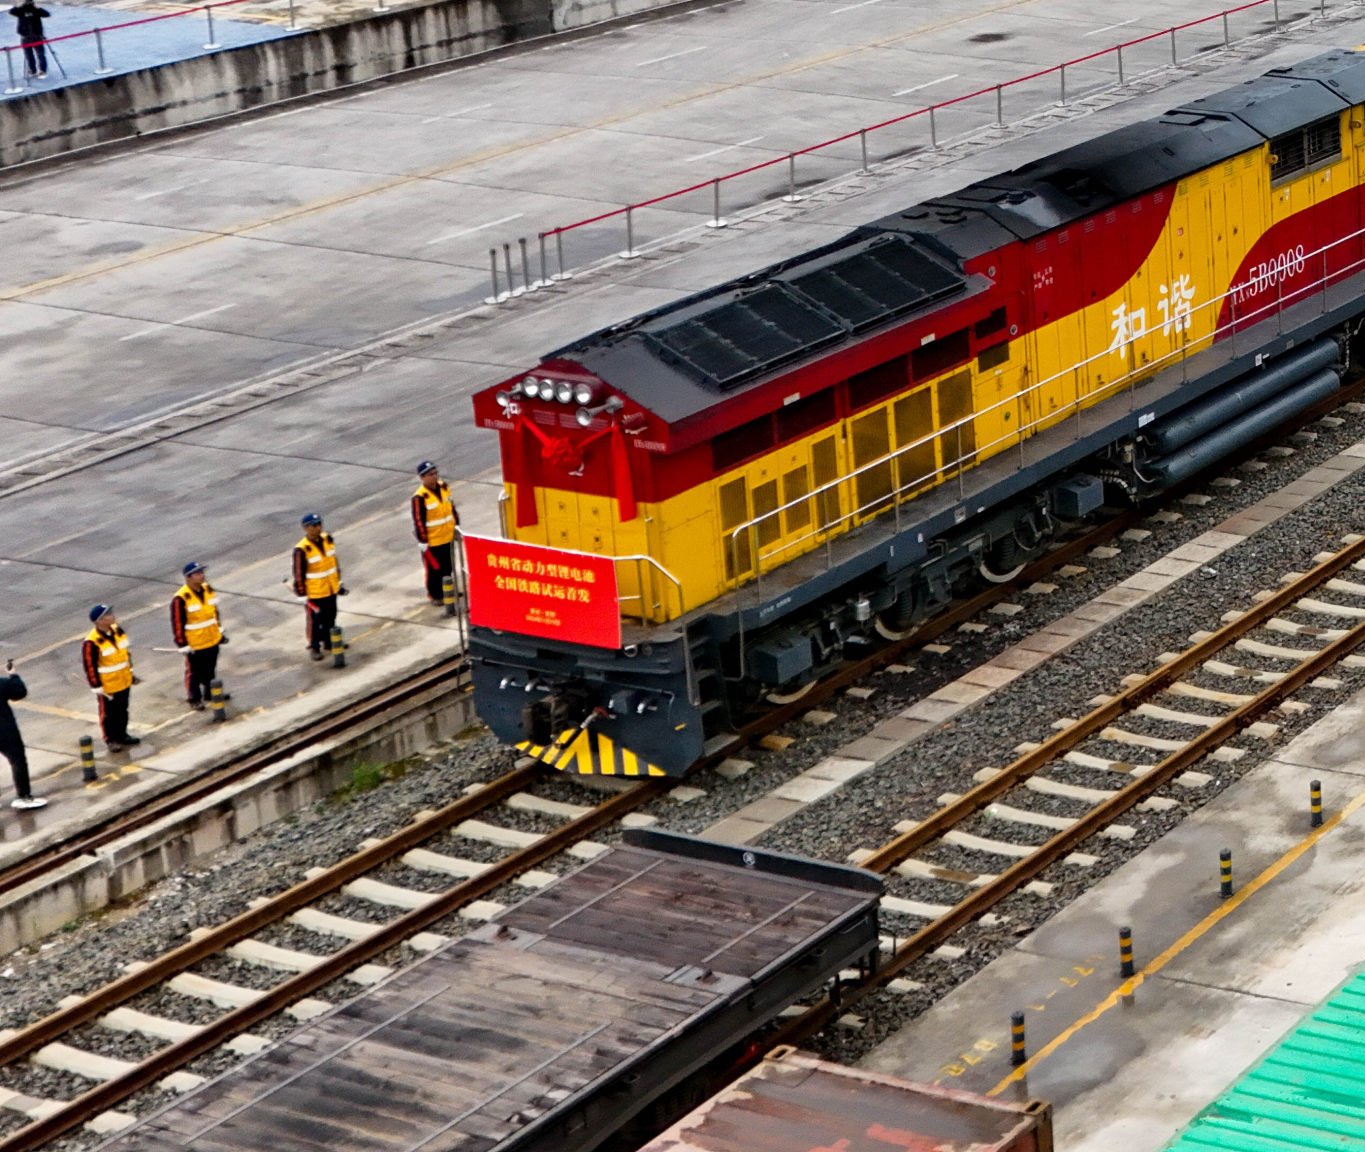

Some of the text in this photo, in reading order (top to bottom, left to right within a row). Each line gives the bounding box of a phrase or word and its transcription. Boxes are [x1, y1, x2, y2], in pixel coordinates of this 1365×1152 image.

[1110, 273, 1196, 359] 和谐
[486, 553, 596, 583] 贵州省动力型锂电池
[494, 575, 590, 603] 全国铁路试运首发
